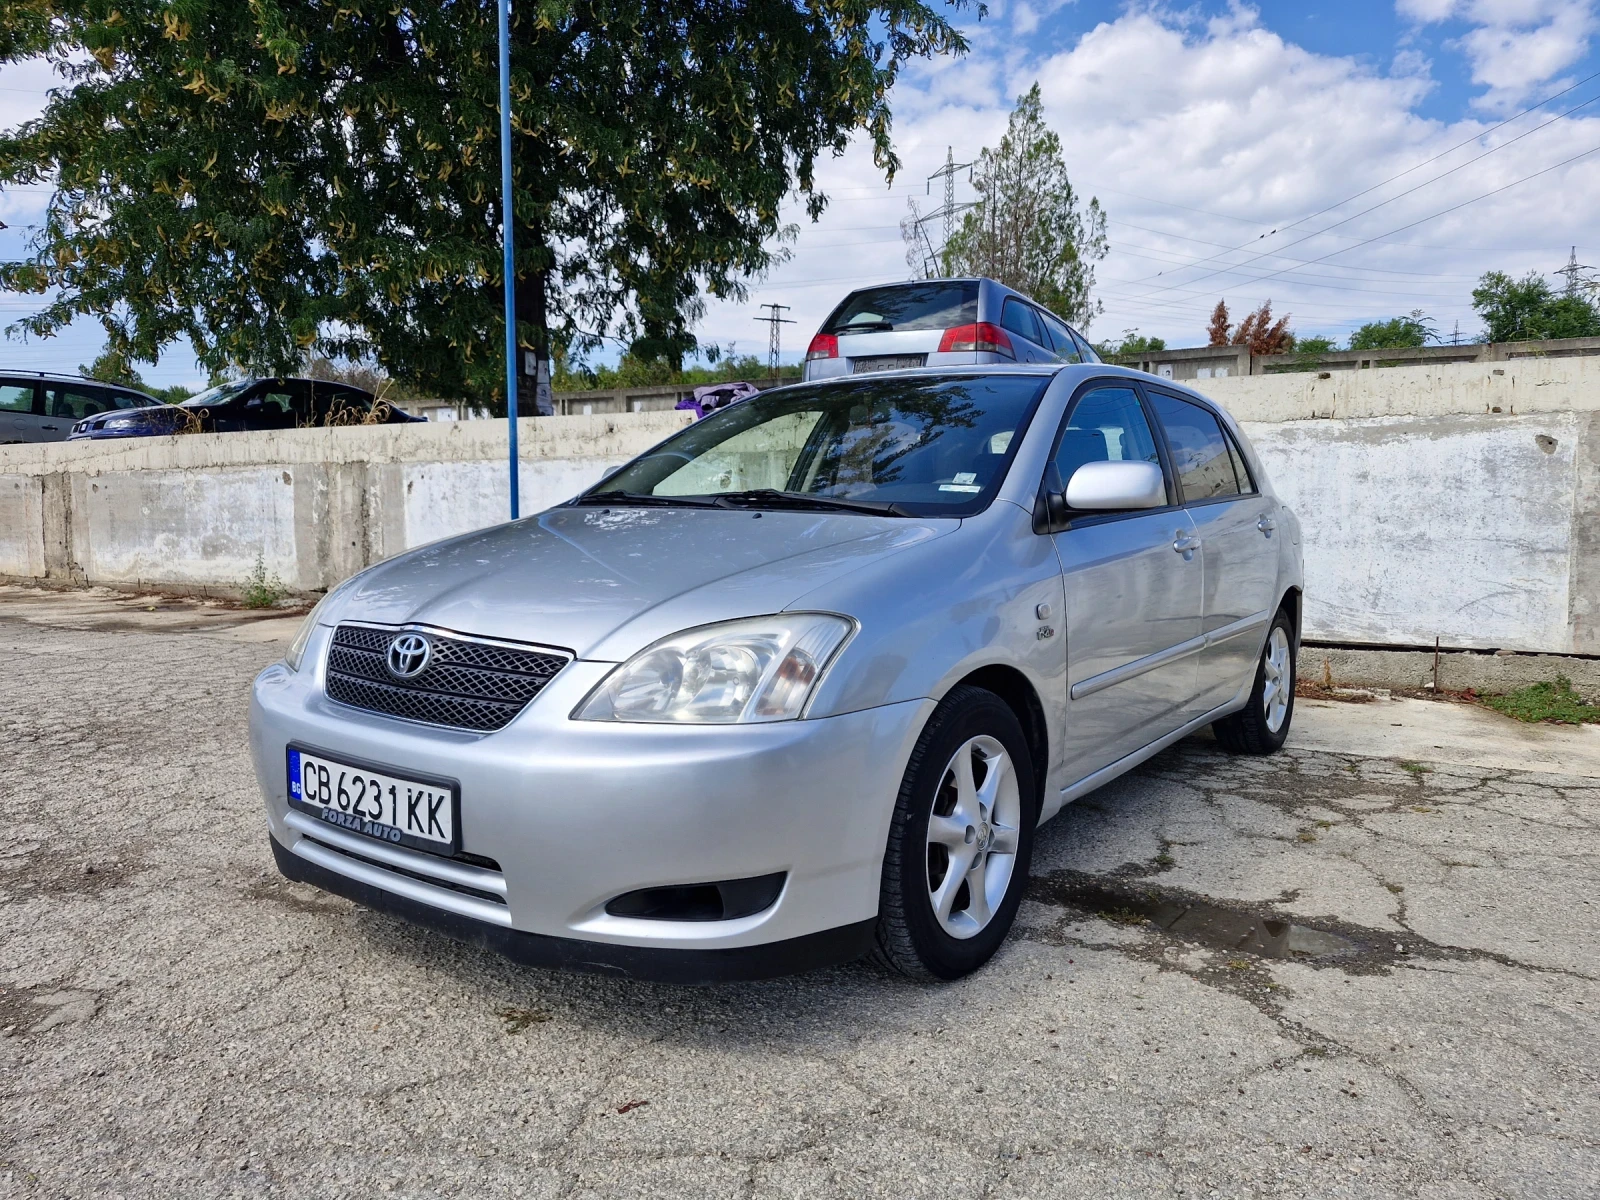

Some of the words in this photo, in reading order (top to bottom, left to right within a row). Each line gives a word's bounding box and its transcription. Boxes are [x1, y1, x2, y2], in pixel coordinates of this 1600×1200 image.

[291, 780, 301, 794] BG
[321, 807, 362, 830] FORZA
[364, 821, 402, 842] AUTO
